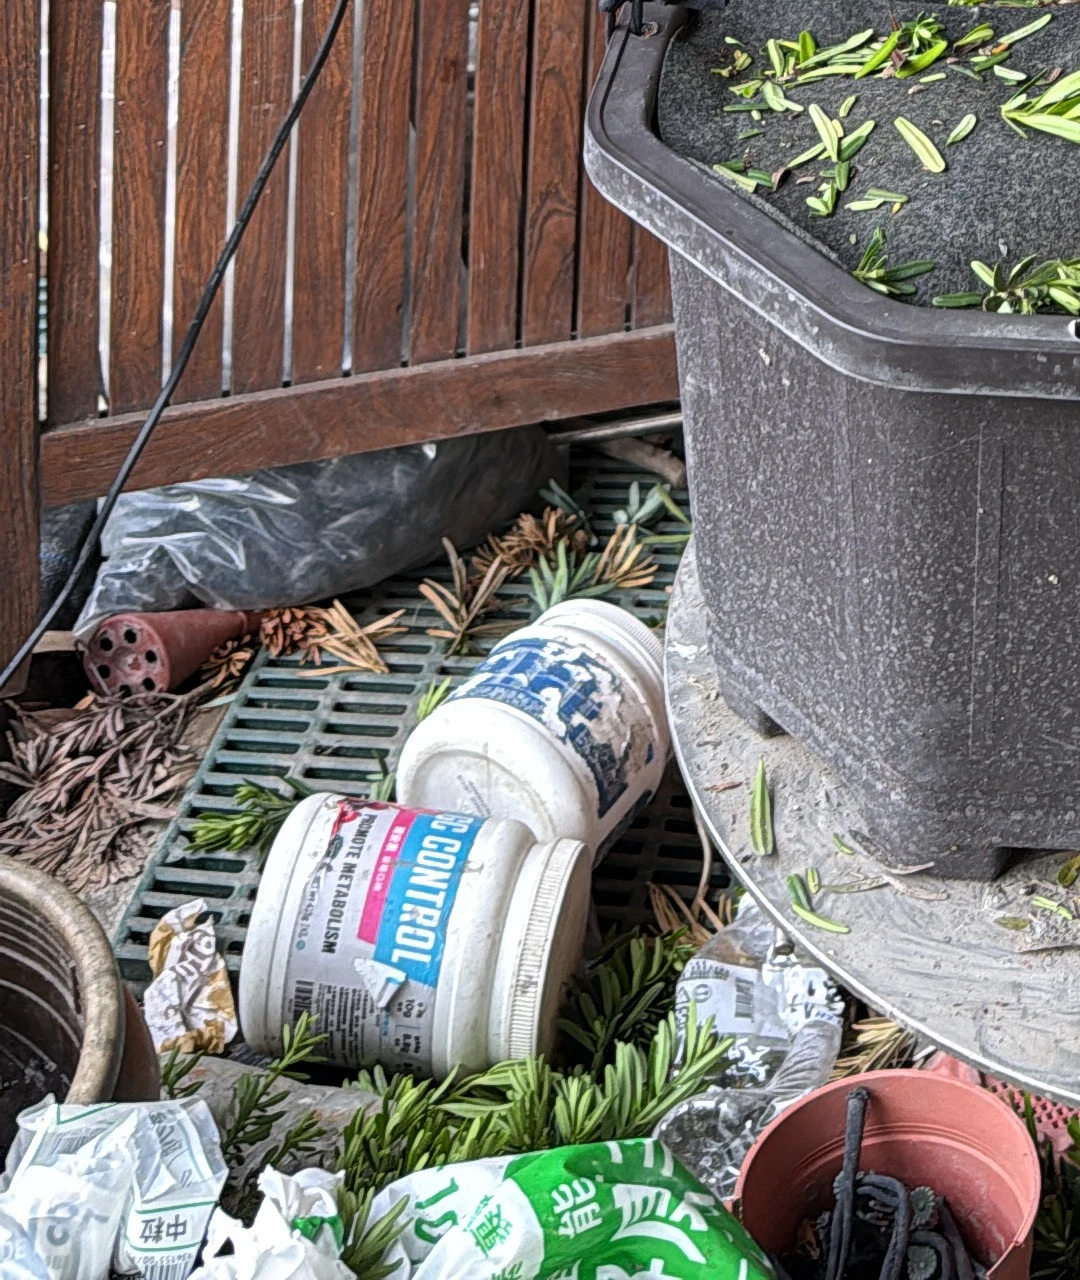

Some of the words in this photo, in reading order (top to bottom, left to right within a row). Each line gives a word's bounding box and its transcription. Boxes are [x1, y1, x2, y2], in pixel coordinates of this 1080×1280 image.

[345, 813, 378, 860] PROMOTE
[321, 862, 358, 954] METABOLISM
[391, 835, 462, 964] CONTROL
[139, 1213, 188, 1243] 中粒
